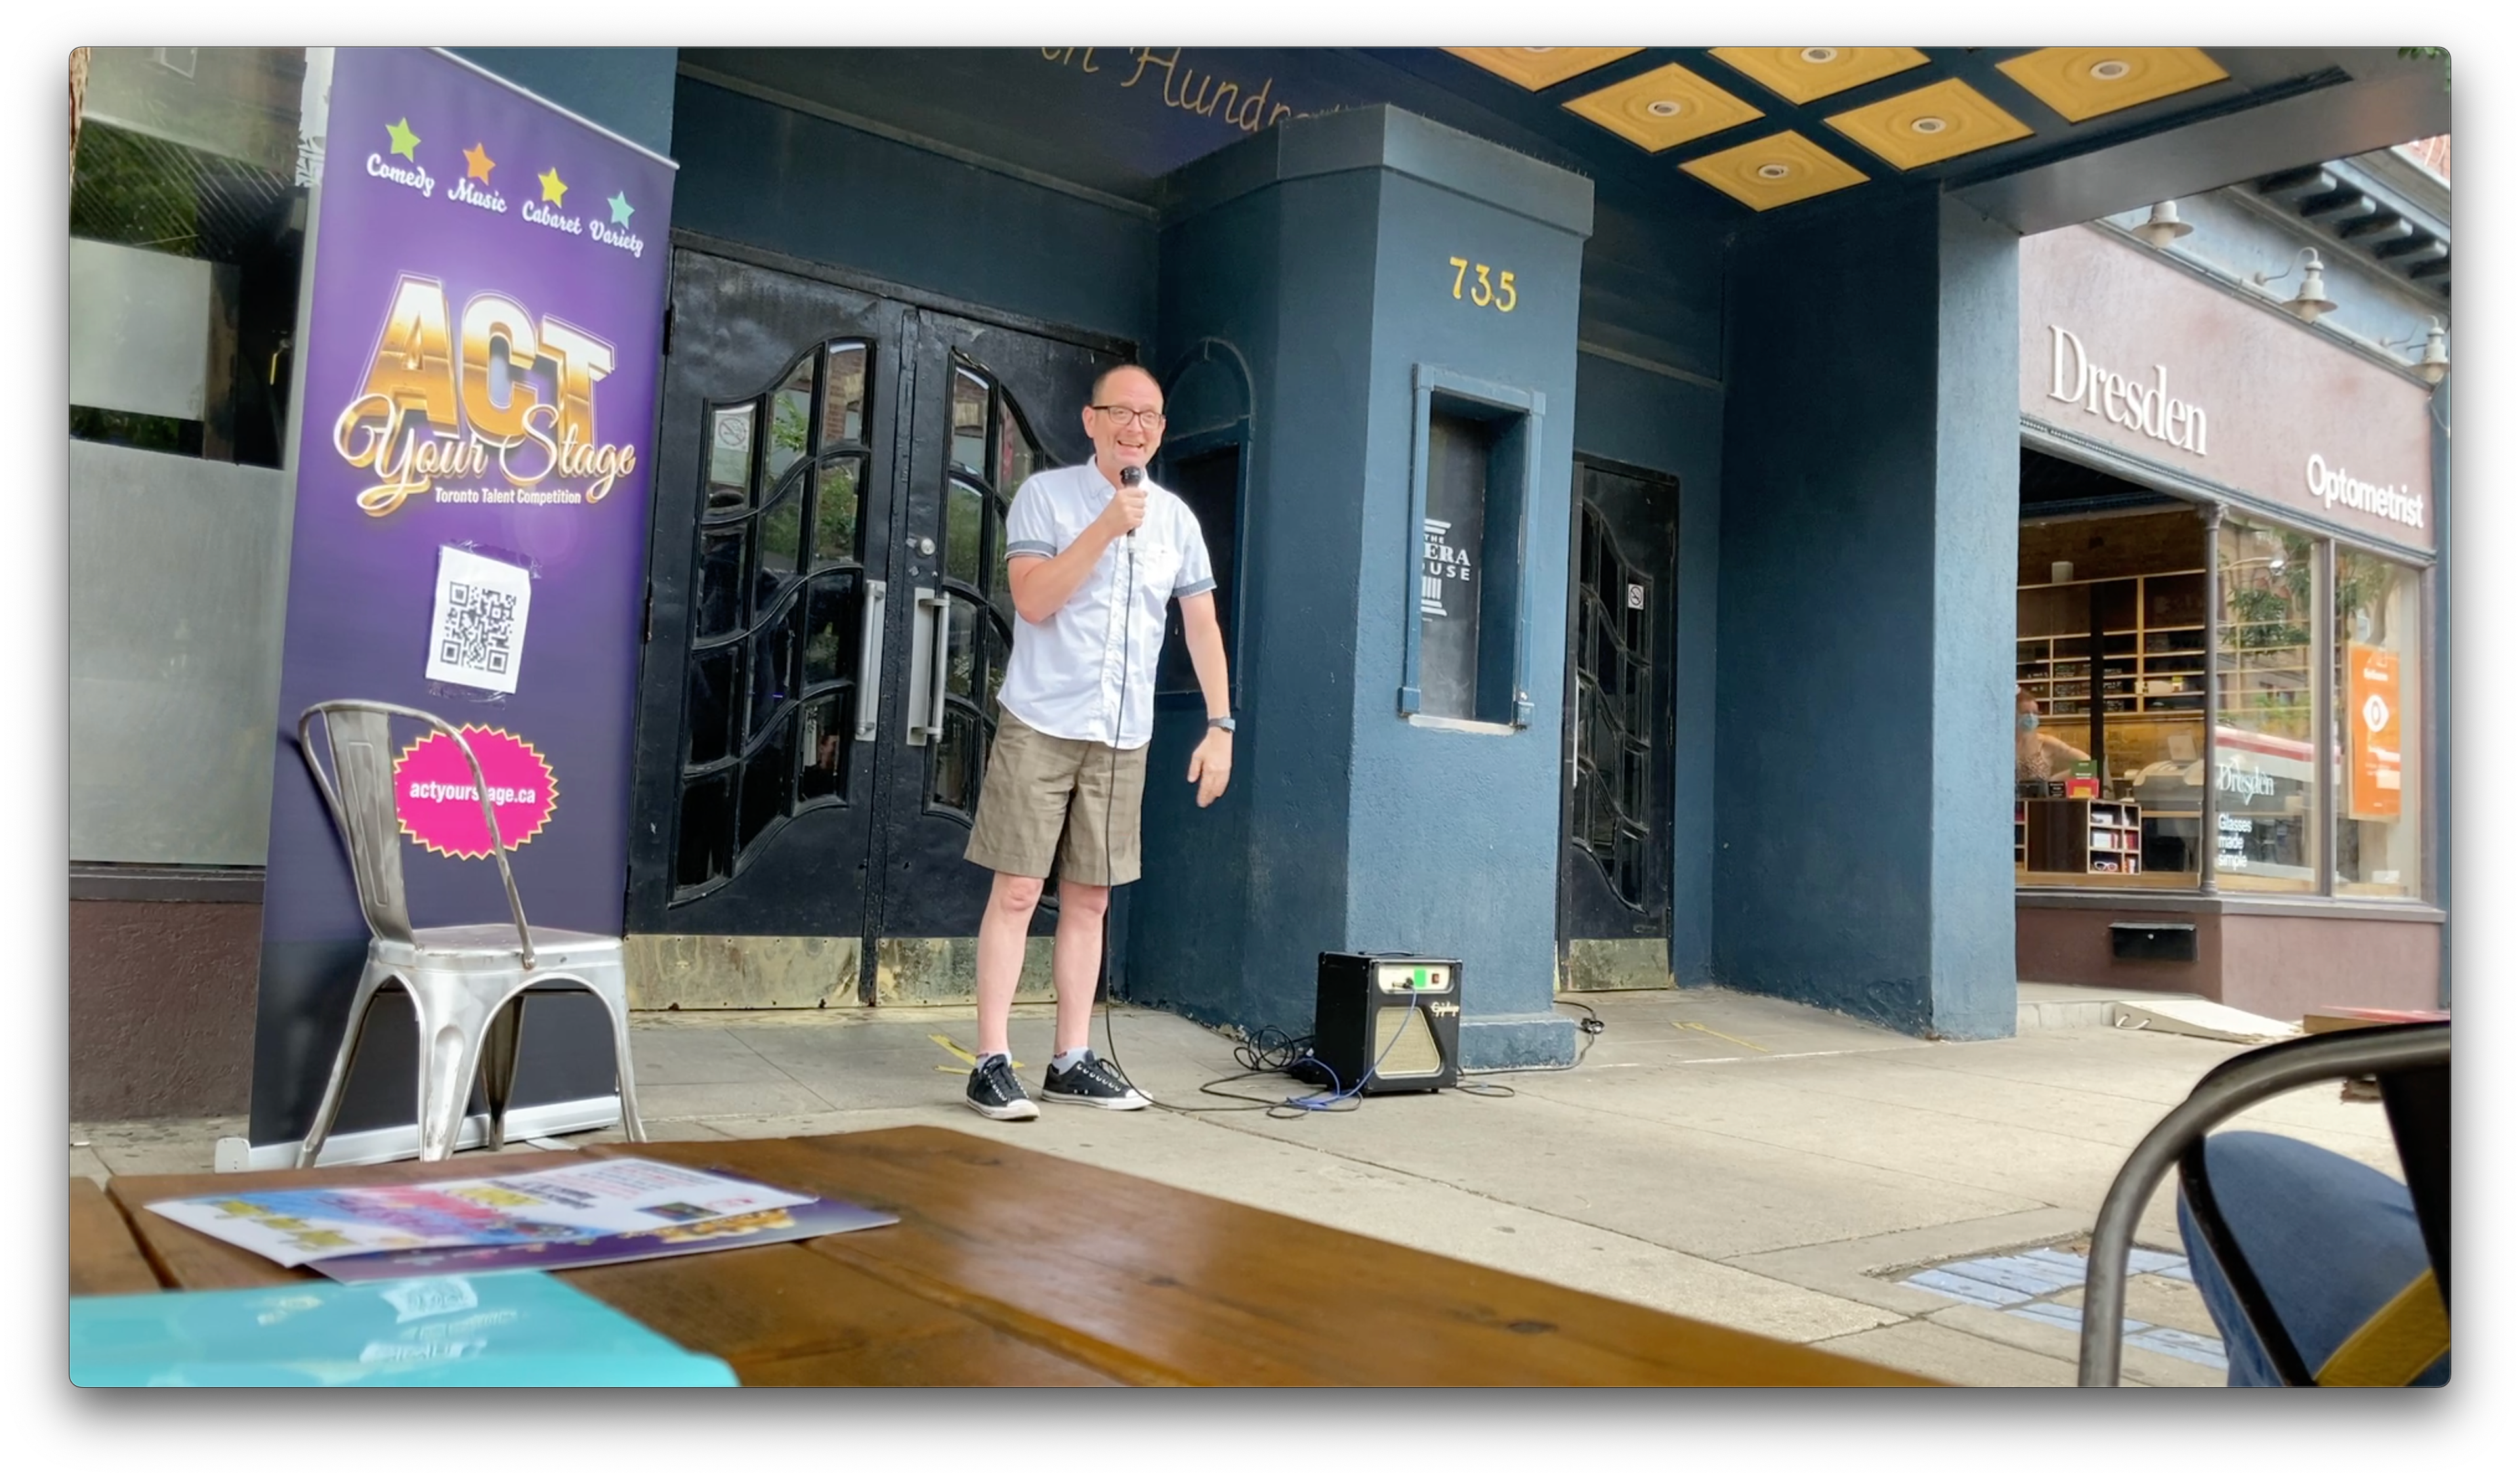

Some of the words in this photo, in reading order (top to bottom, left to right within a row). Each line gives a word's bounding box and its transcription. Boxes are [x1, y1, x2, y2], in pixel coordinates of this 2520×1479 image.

[1121, 48, 1310, 132] Hundr
[367, 152, 434, 198] Comedy
[448, 178, 507, 213] Music
[522, 200, 582, 236] Cabaret
[589, 219, 644, 258] Variety
[1449, 257, 1517, 312] 735
[353, 271, 616, 456] ACT
[2048, 324, 2208, 457] Dresden
[333, 393, 488, 516] Your
[499, 404, 636, 504] Stage
[435, 487, 479, 504] Toronto
[482, 488, 514, 504] Talent
[517, 489, 581, 506] Competition
[2306, 454, 2425, 529] Optometrist
[1422, 561, 1471, 581] USE
[1423, 542, 1471, 567] ERA
[410, 781, 536, 806] actyoursage.ca
[2218, 813, 2252, 833] Glasses
[2218, 832, 2244, 849] made
[2218, 849, 2248, 871] simple
